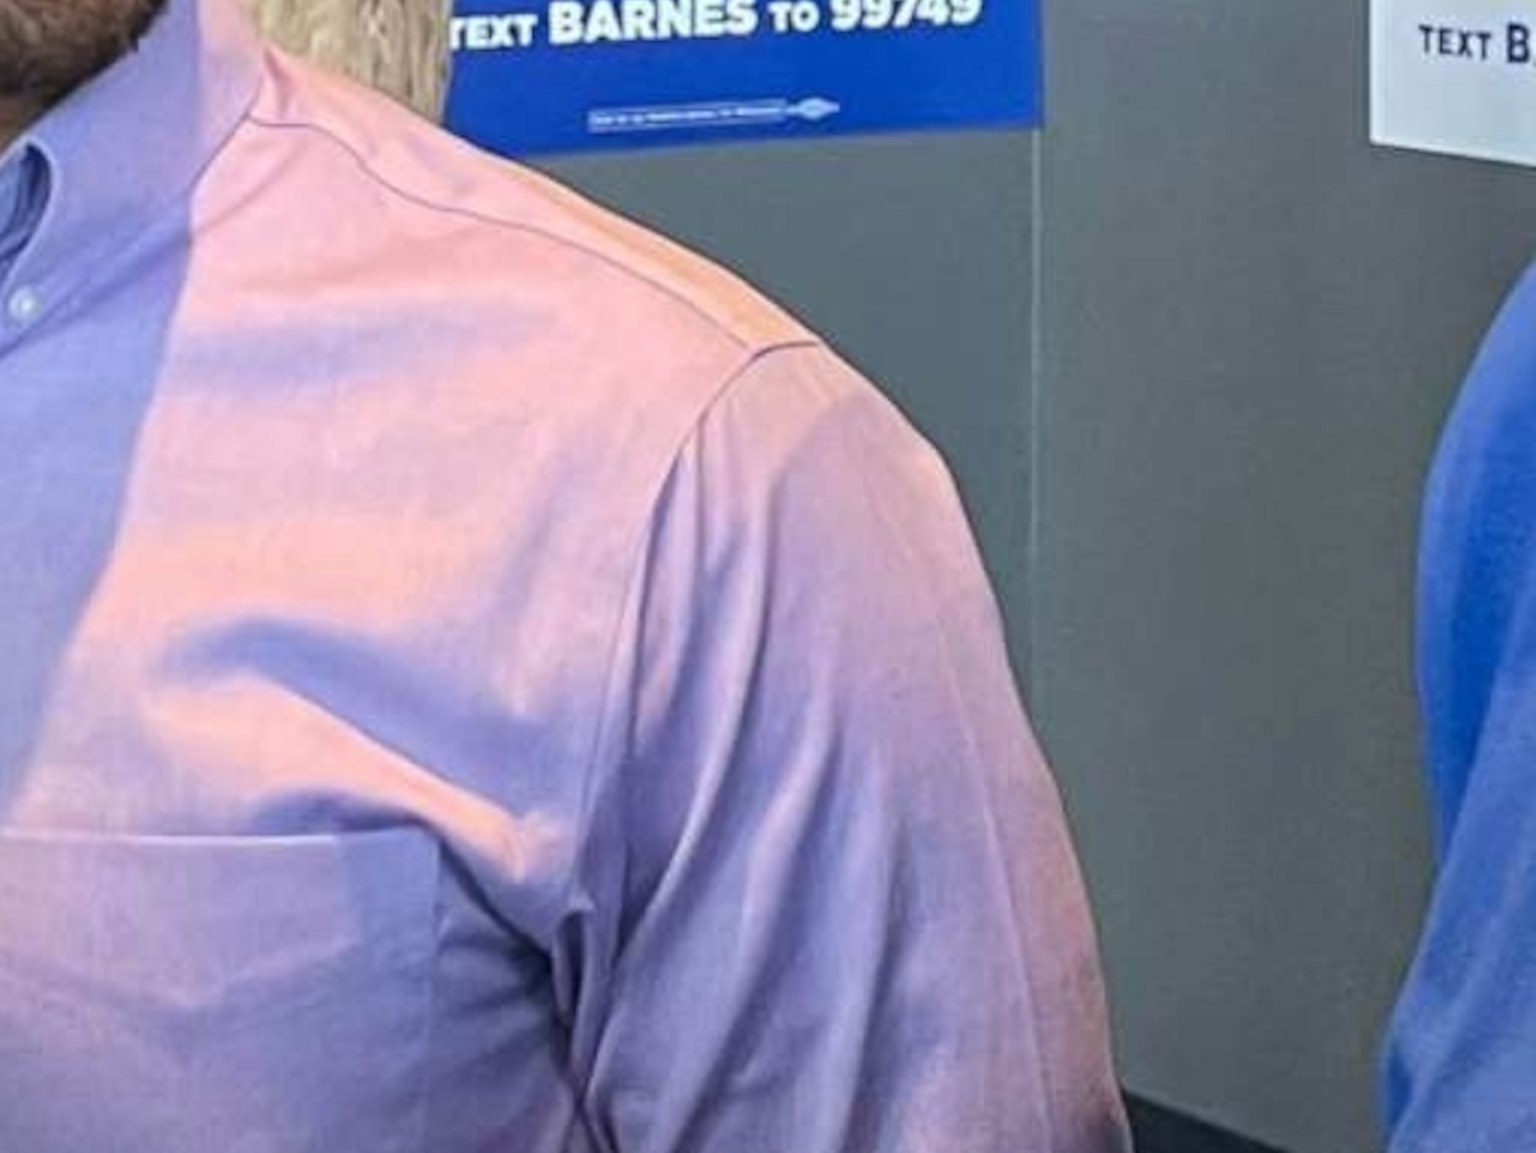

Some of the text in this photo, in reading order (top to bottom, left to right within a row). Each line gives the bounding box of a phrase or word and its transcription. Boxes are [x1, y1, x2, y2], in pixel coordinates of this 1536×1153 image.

[451, 13, 538, 50] TEXT
[768, 0, 820, 32] TO
[1418, 23, 1492, 62] TEXT
